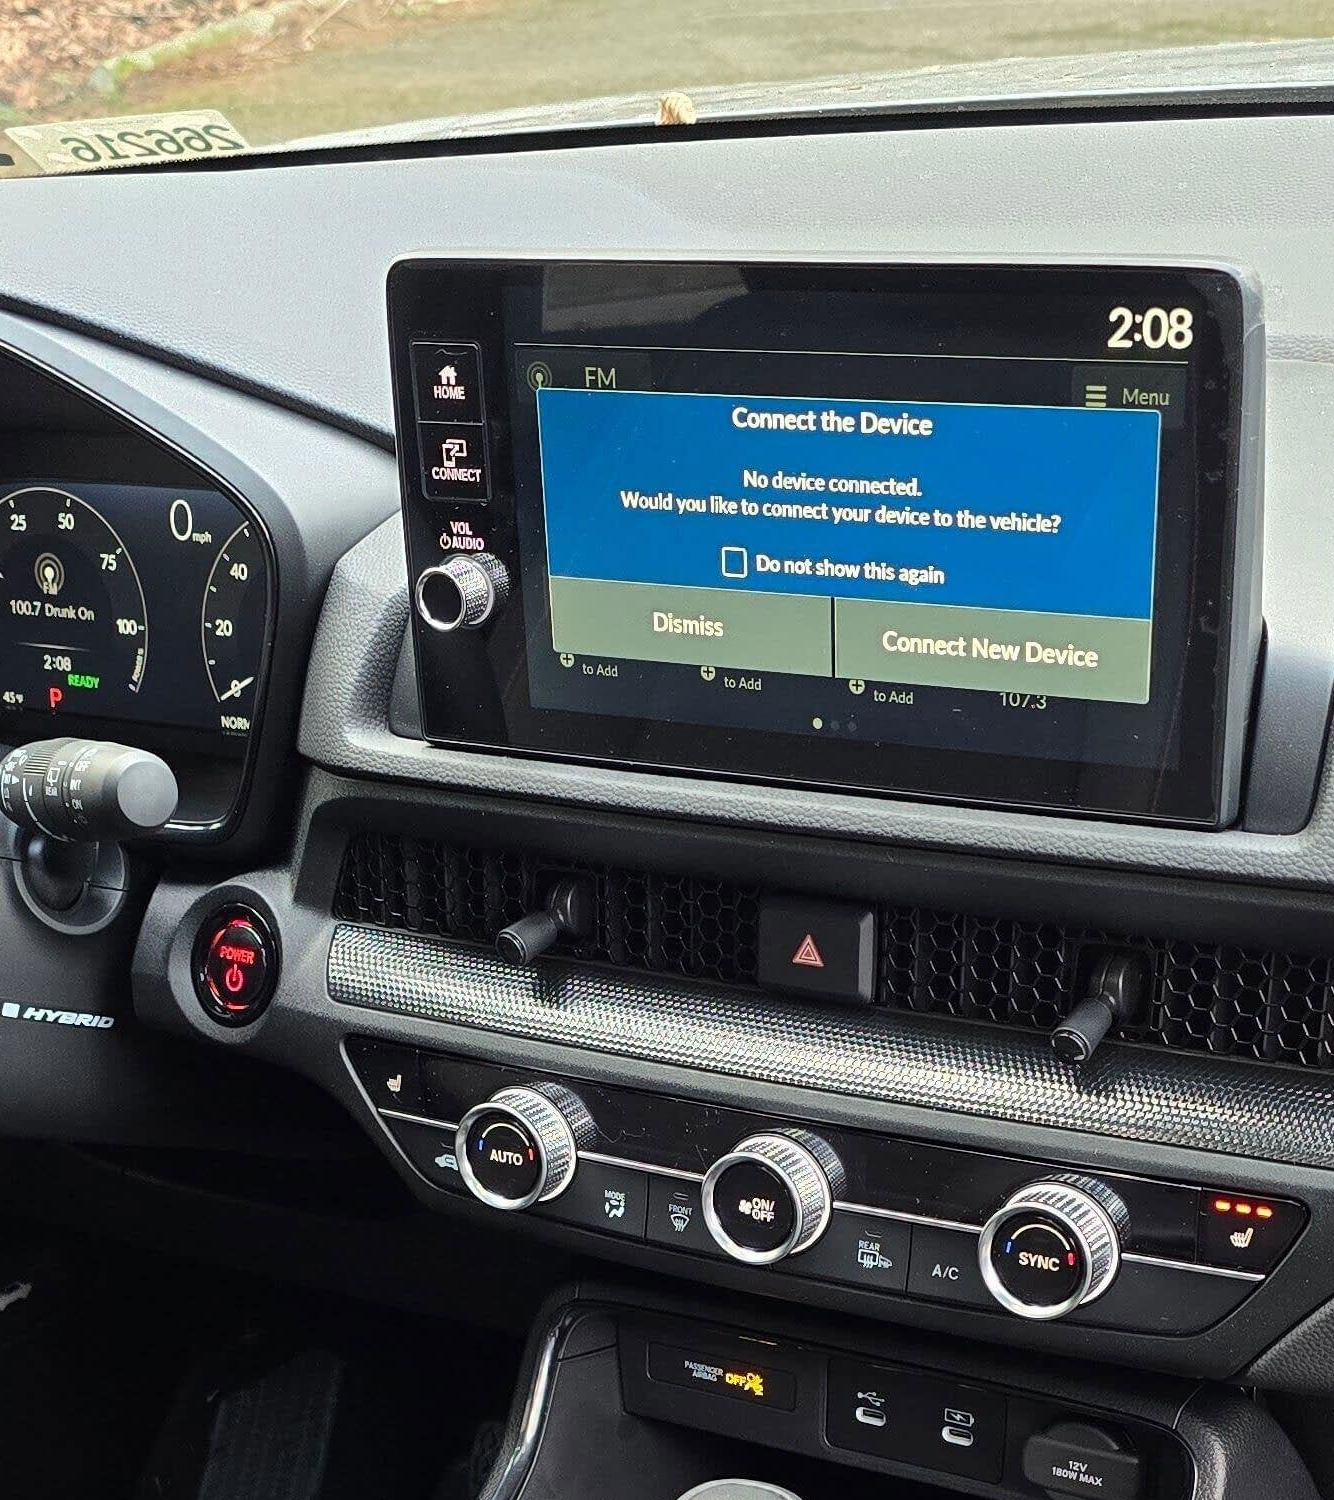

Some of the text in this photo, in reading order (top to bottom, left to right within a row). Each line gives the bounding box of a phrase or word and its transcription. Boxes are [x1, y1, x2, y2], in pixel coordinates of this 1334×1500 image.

[1107, 306, 1193, 349] 2:08
[584, 366, 616, 389] FM
[433, 385, 466, 400] HOME
[1122, 388, 1170, 406] Menu
[731, 406, 933, 436] Connect the Device
[431, 466, 482, 483] CONNECT
[743, 470, 923, 497] No device connected.
[57, 513, 75, 530] 50
[620, 490, 1062, 535] Would you like to connect your device to the vehicle?
[10, 514, 27, 532] 25
[169, 499, 212, 545] 0 mph
[450, 521, 473, 536] VOL
[451, 536, 485, 551] AUDIO
[99, 554, 117, 572] 75
[229, 563, 248, 581] 40
[756, 554, 945, 587] Do not show this again
[9, 599, 95, 621] 100.7 Drunk On
[116, 618, 138, 636] 100
[214, 619, 233, 637] 20
[652, 611, 724, 639] Dismiss
[882, 631, 1099, 669] Connect New Device
[43, 654, 72, 672] 2:08
[582, 662, 619, 679] to Add
[67, 673, 100, 689] READY
[723, 675, 762, 692] to Add
[49, 687, 63, 708] P
[873, 688, 914, 706] to Add
[999, 691, 1048, 711] 107.3
[219, 945, 255, 965] POWER
[22, 1006, 115, 1029] HYBRID
[489, 1148, 524, 1166] AUTO
[604, 1189, 626, 1202] MODE
[668, 1203, 693, 1216] FRONT
[751, 1209, 775, 1222] OFF
[858, 1239, 881, 1251] REAR
[1018, 1251, 1060, 1272] SYNC
[931, 1263, 959, 1280] A/C
[725, 1372, 747, 1387] OFF
[1068, 1460, 1088, 1473] 12V
[1051, 1466, 1103, 1487] 180W MAX
